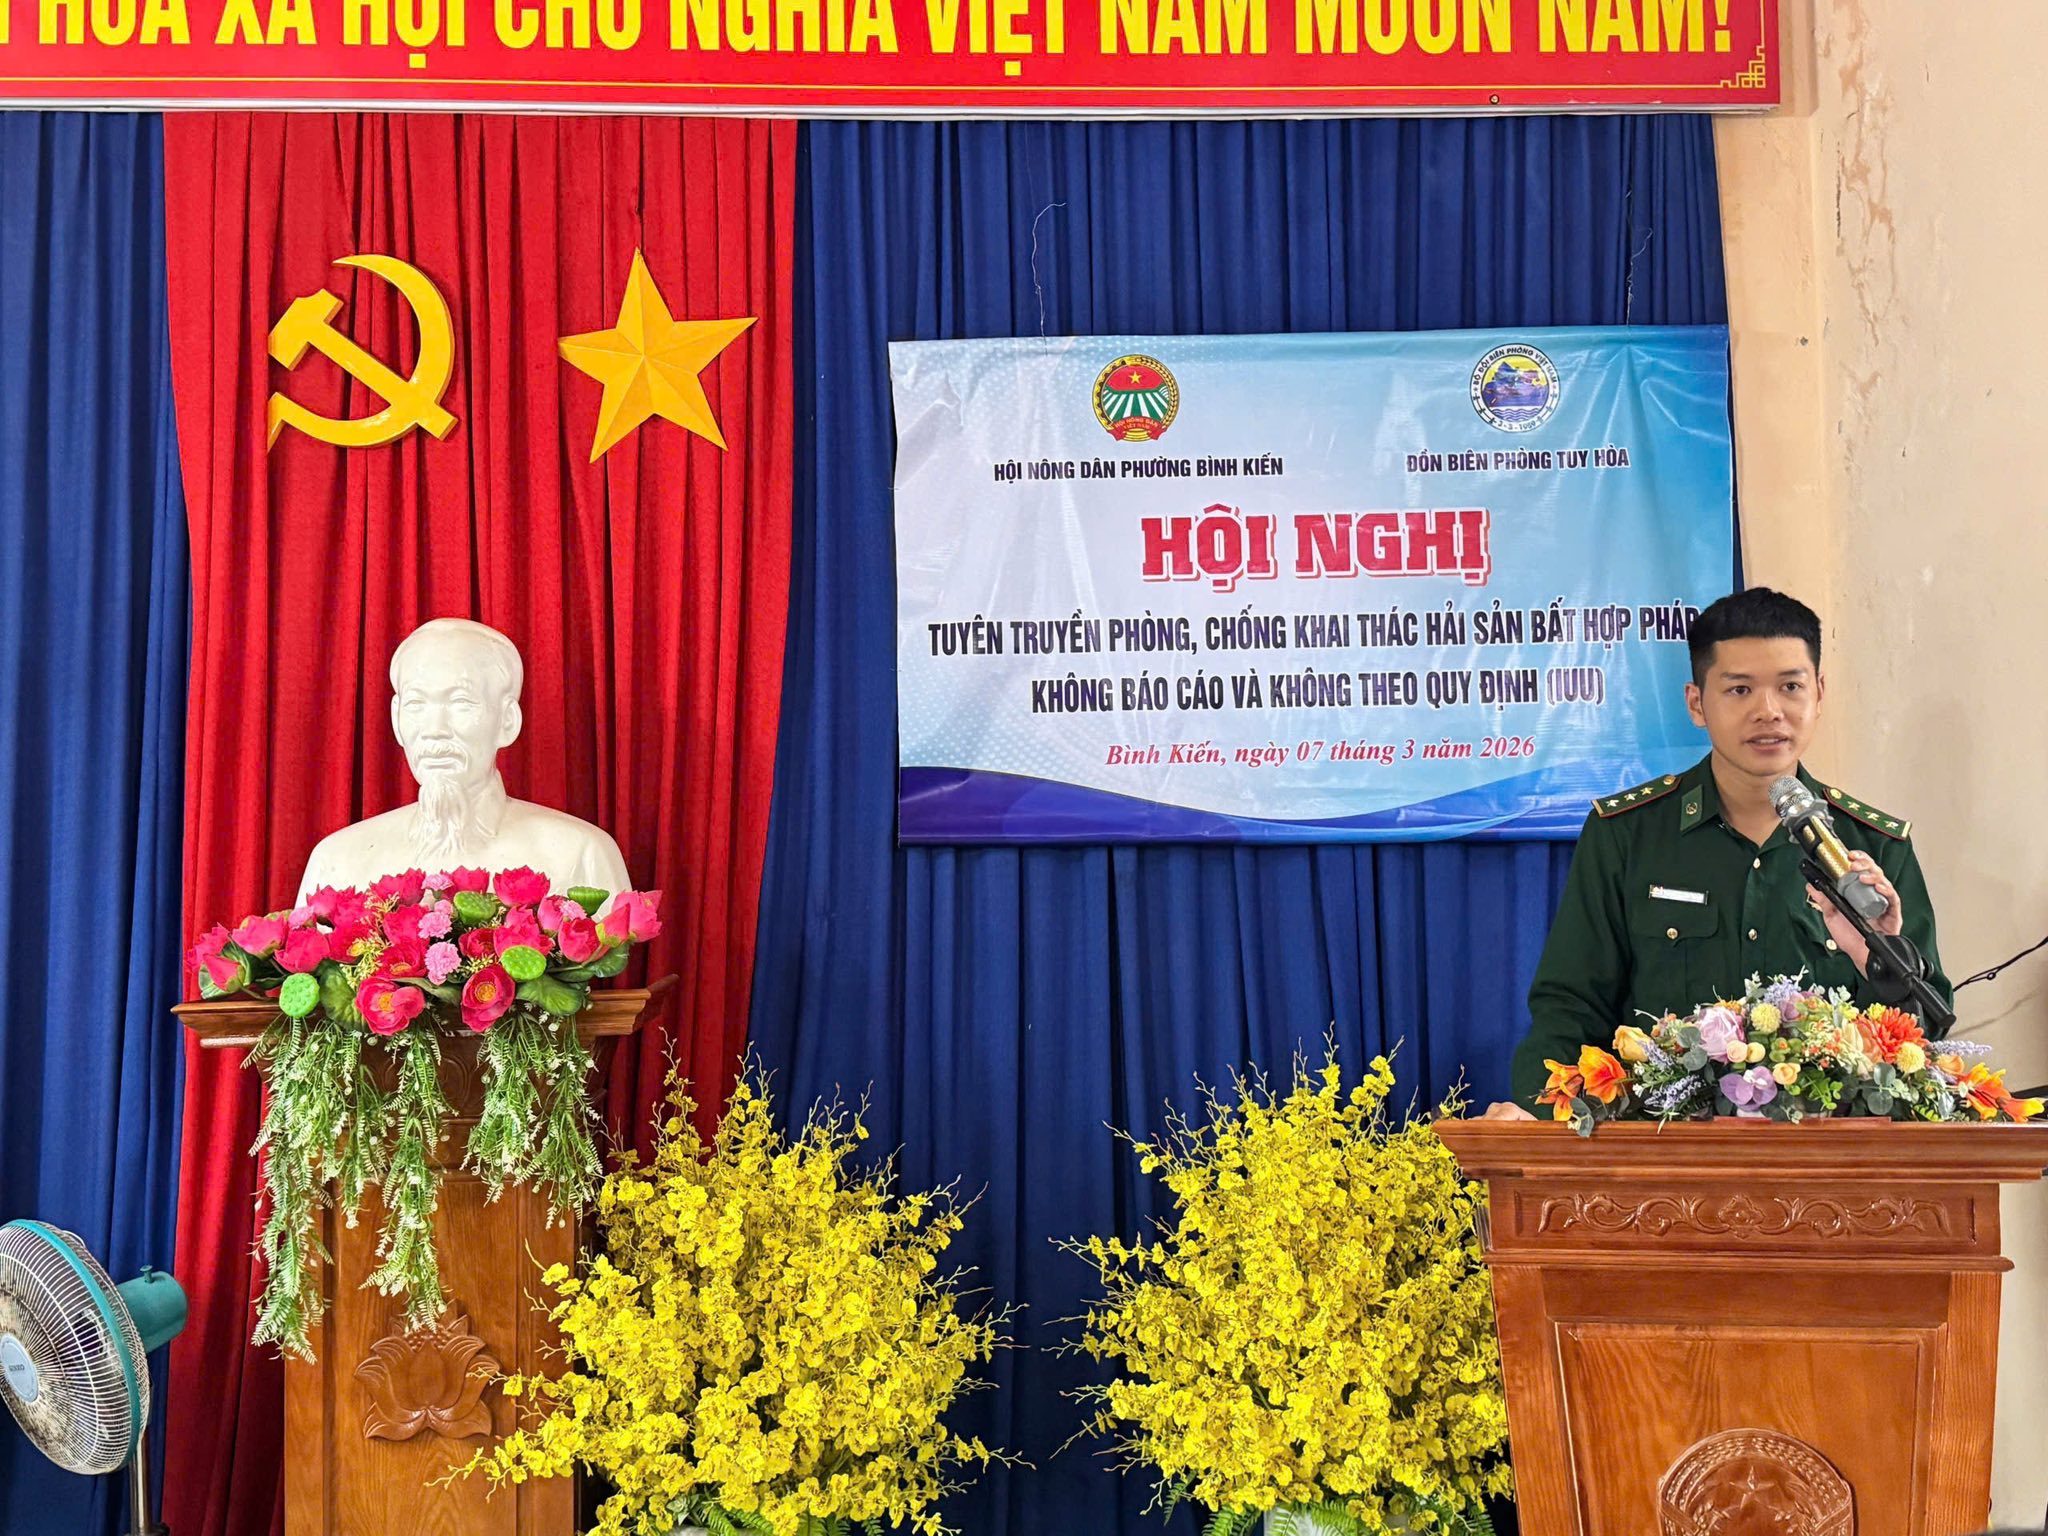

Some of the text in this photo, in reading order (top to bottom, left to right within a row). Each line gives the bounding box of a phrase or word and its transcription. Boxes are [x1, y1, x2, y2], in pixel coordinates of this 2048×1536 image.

[994, 452, 1283, 484] HỘI NÔNG DÂN PHƯỜNG BÌNH KIẾN
[1407, 444, 1629, 473] ĐỒN BIÊN PHÒNG TUY HÒA
[1141, 503, 1492, 594] HỘI NGHỊ
[927, 614, 1003, 656] TUYÊN
[1009, 608, 1101, 655] TRUYỀN
[1108, 609, 1197, 655] PHÒNG,
[1205, 604, 1287, 651] CHỐNG
[1294, 614, 1350, 648] KHAI
[1356, 605, 1418, 647] THÁC
[1425, 600, 1466, 646] HẢI
[1473, 599, 1523, 645] SẢN
[1530, 596, 1576, 644] BẤT
[1583, 604, 1631, 649] HỢP
[1031, 666, 1606, 714] KHÔNG BÁO CÁO VÀ KHÔNG THEO QUY ĐỊNH (IUU)
[1105, 736, 1535, 768] Bình Kiến, ngày 07 tháng 3 năm 2026
